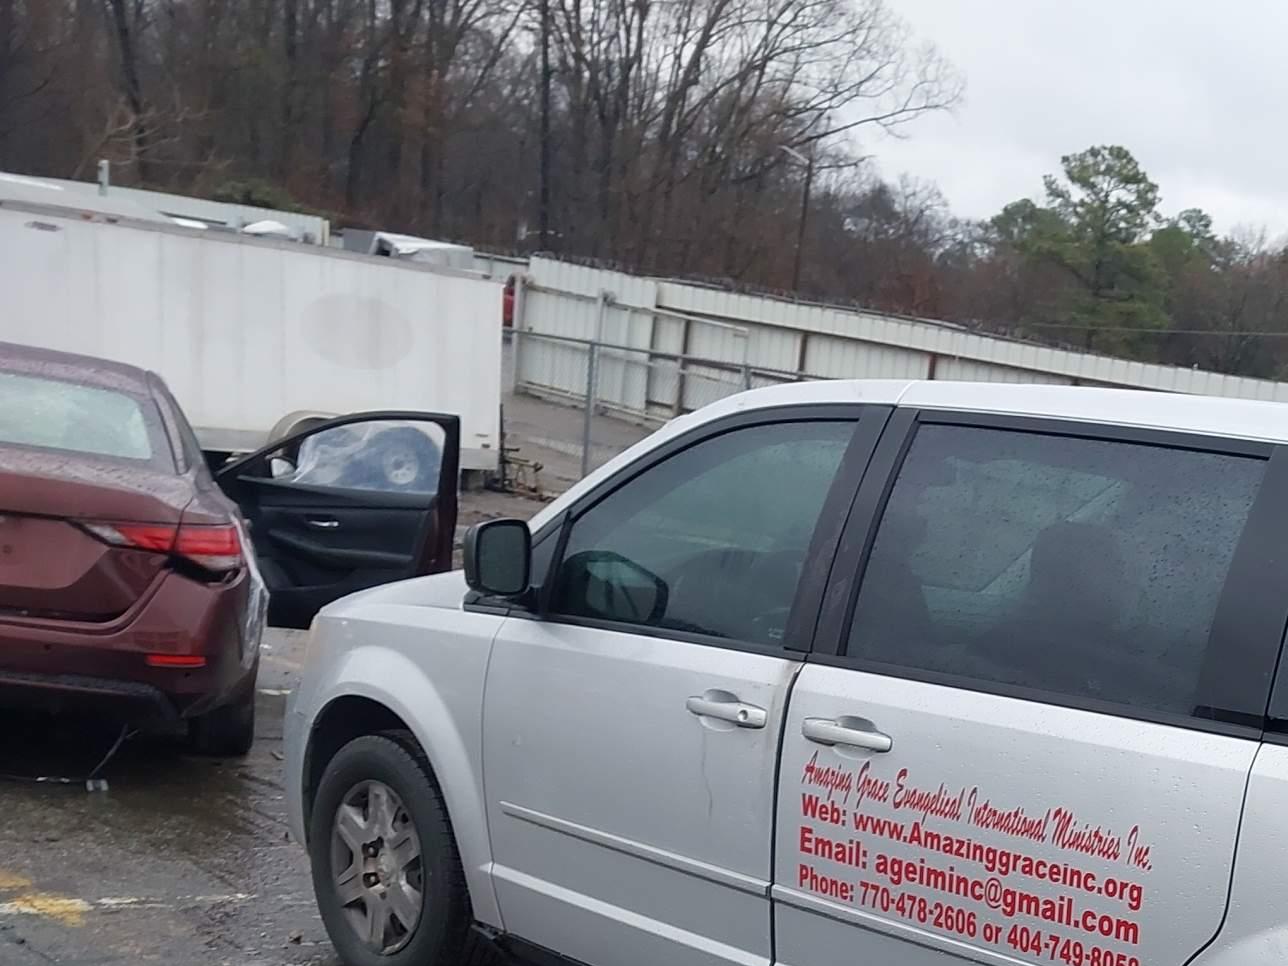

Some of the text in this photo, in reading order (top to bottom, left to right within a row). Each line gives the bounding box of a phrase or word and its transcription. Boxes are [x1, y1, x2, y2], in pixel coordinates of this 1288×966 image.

[801, 750, 1153, 871] Amazing Grace Evangelical International Ministries Inc.
[802, 793, 1143, 910] Web: www.Amazinggraceinc.org
[799, 826, 1139, 944] Email: ageiminc@gmail.com
[799, 863, 855, 902] Phone:
[860, 880, 978, 938] 770-478-2606
[983, 922, 1003, 945] or
